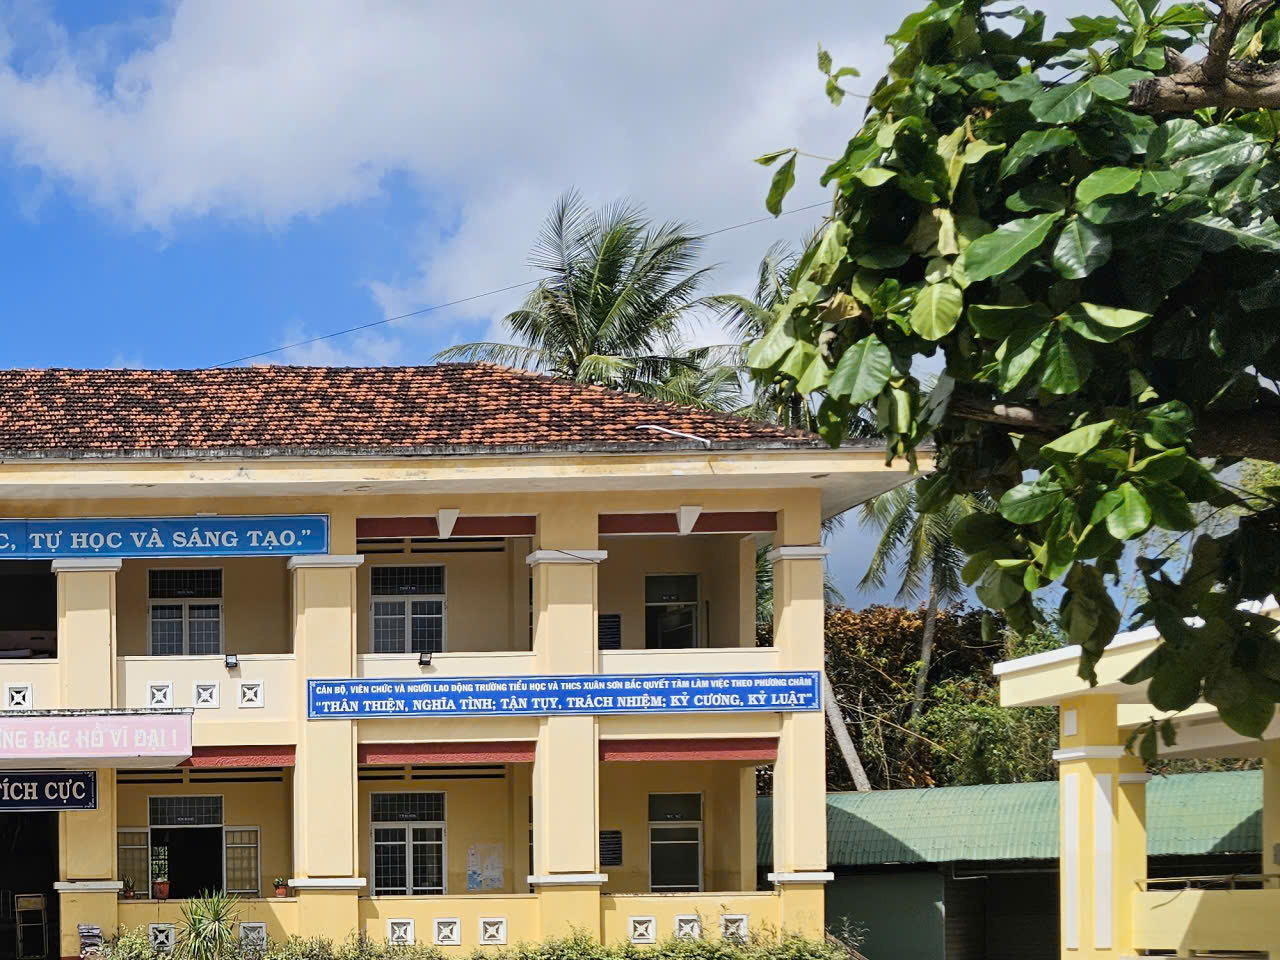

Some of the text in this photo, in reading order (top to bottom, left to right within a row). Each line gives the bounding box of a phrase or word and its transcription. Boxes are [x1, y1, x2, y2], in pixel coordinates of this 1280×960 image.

[29, 530, 63, 552] TỰ
[70, 532, 122, 552] HỌC
[130, 527, 162, 548] VÀ
[172, 526, 238, 548] SÁNG
[351, 684, 369, 693] VIÊN
[395, 683, 405, 692] VÀ
[434, 684, 449, 692] LAO
[530, 683, 546, 691] HỌC
[548, 681, 558, 690] VÀ
[584, 680, 605, 689] XUÂN
[607, 681, 623, 689] SƠN
[731, 679, 752, 687] THEO
[500, 696, 527, 711] TẬN
[567, 694, 613, 707] TRÁCH
[44, 778, 86, 803] CỰC
